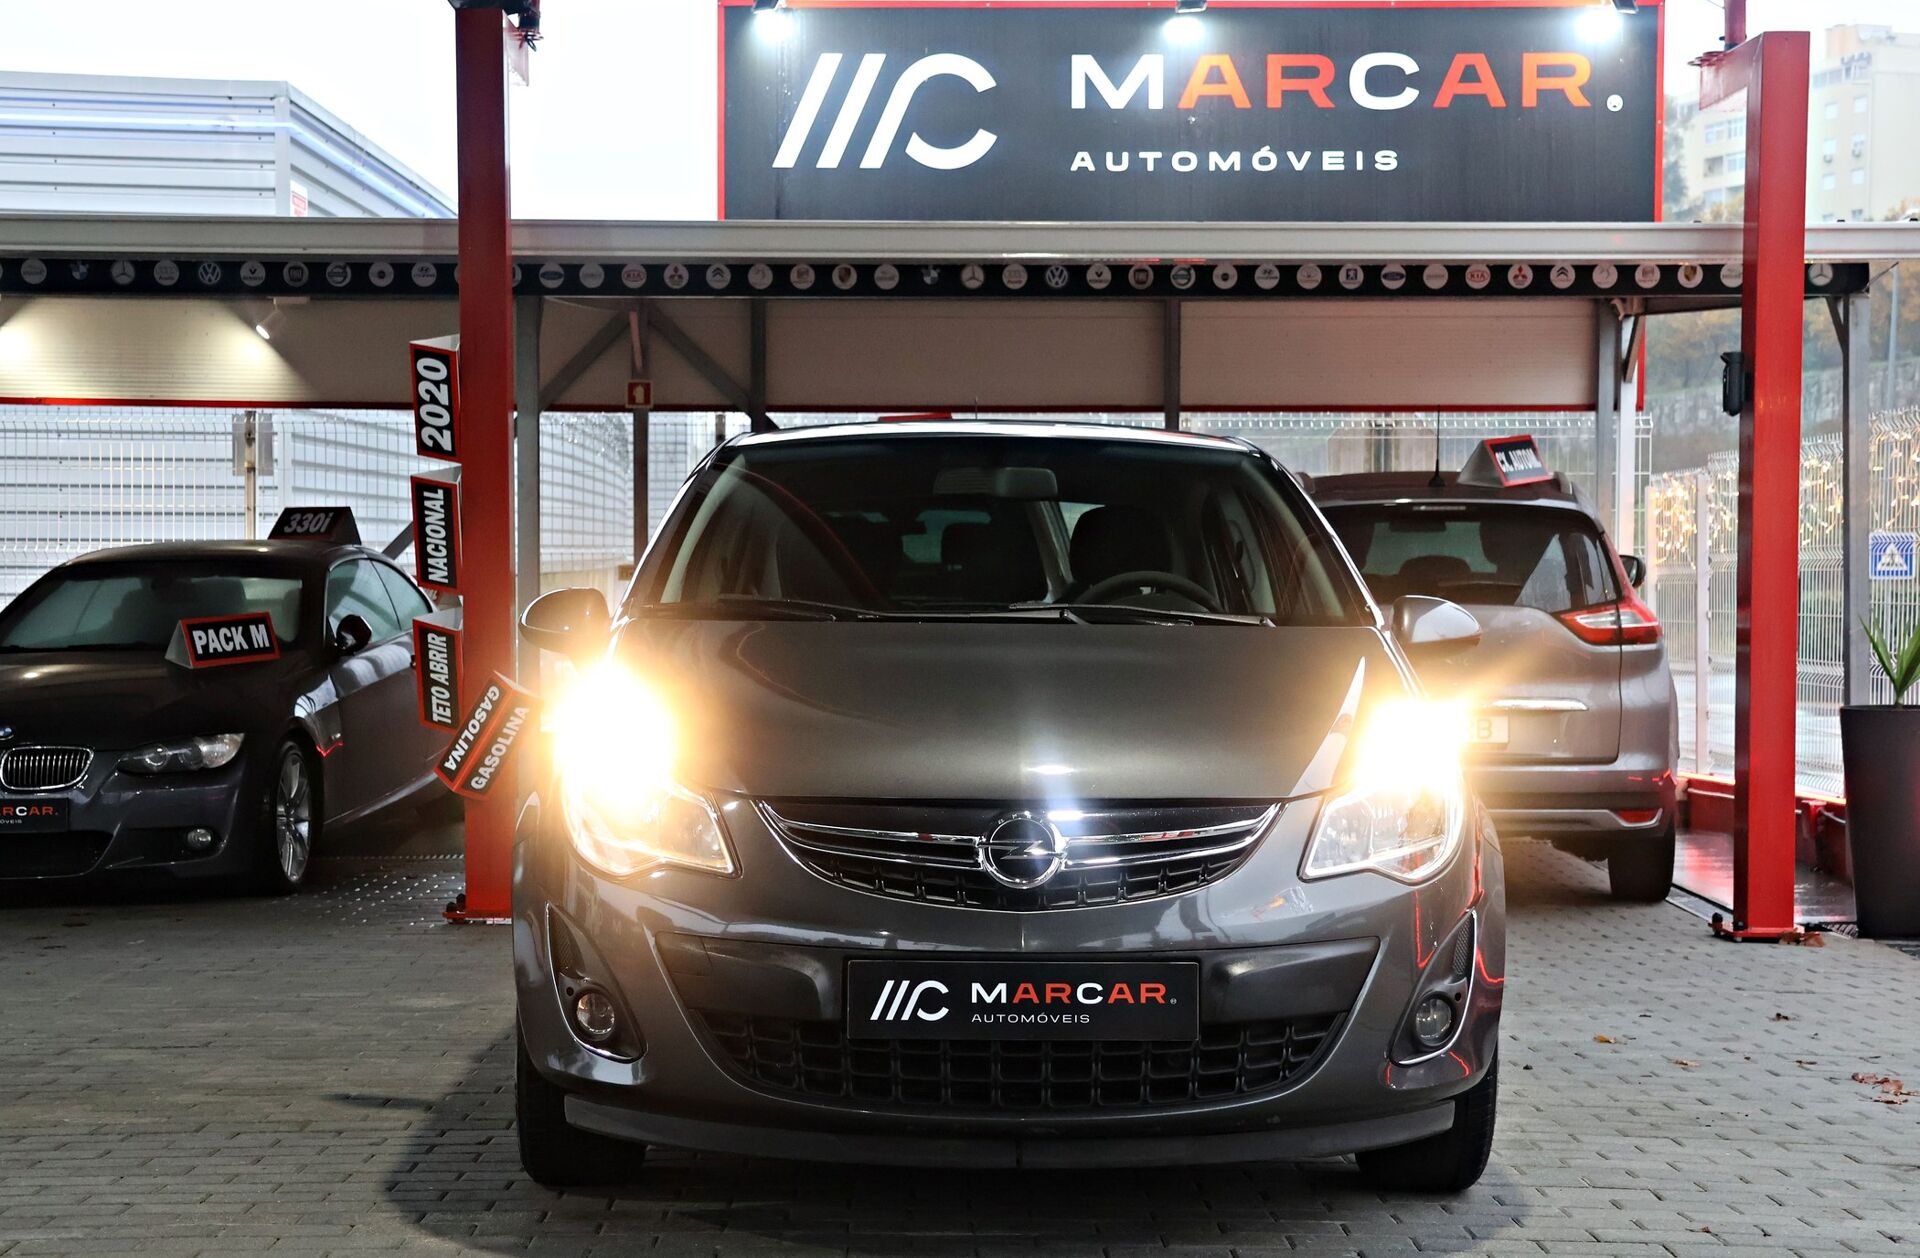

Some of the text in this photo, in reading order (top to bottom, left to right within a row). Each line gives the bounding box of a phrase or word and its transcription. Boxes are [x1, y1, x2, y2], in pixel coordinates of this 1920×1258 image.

[1070, 146, 1399, 172] AUTOMÓVEIS
[416, 357, 453, 452] 2020
[284, 512, 334, 533] 330i
[423, 489, 449, 583] NACIONAL
[192, 623, 270, 655] PACK M
[427, 632, 452, 724] TETO ABRIR
[444, 685, 500, 771] GASOLINA
[470, 706, 530, 790] GASOLINA
[971, 1012, 1090, 1024] AUTOMÓVEIS
